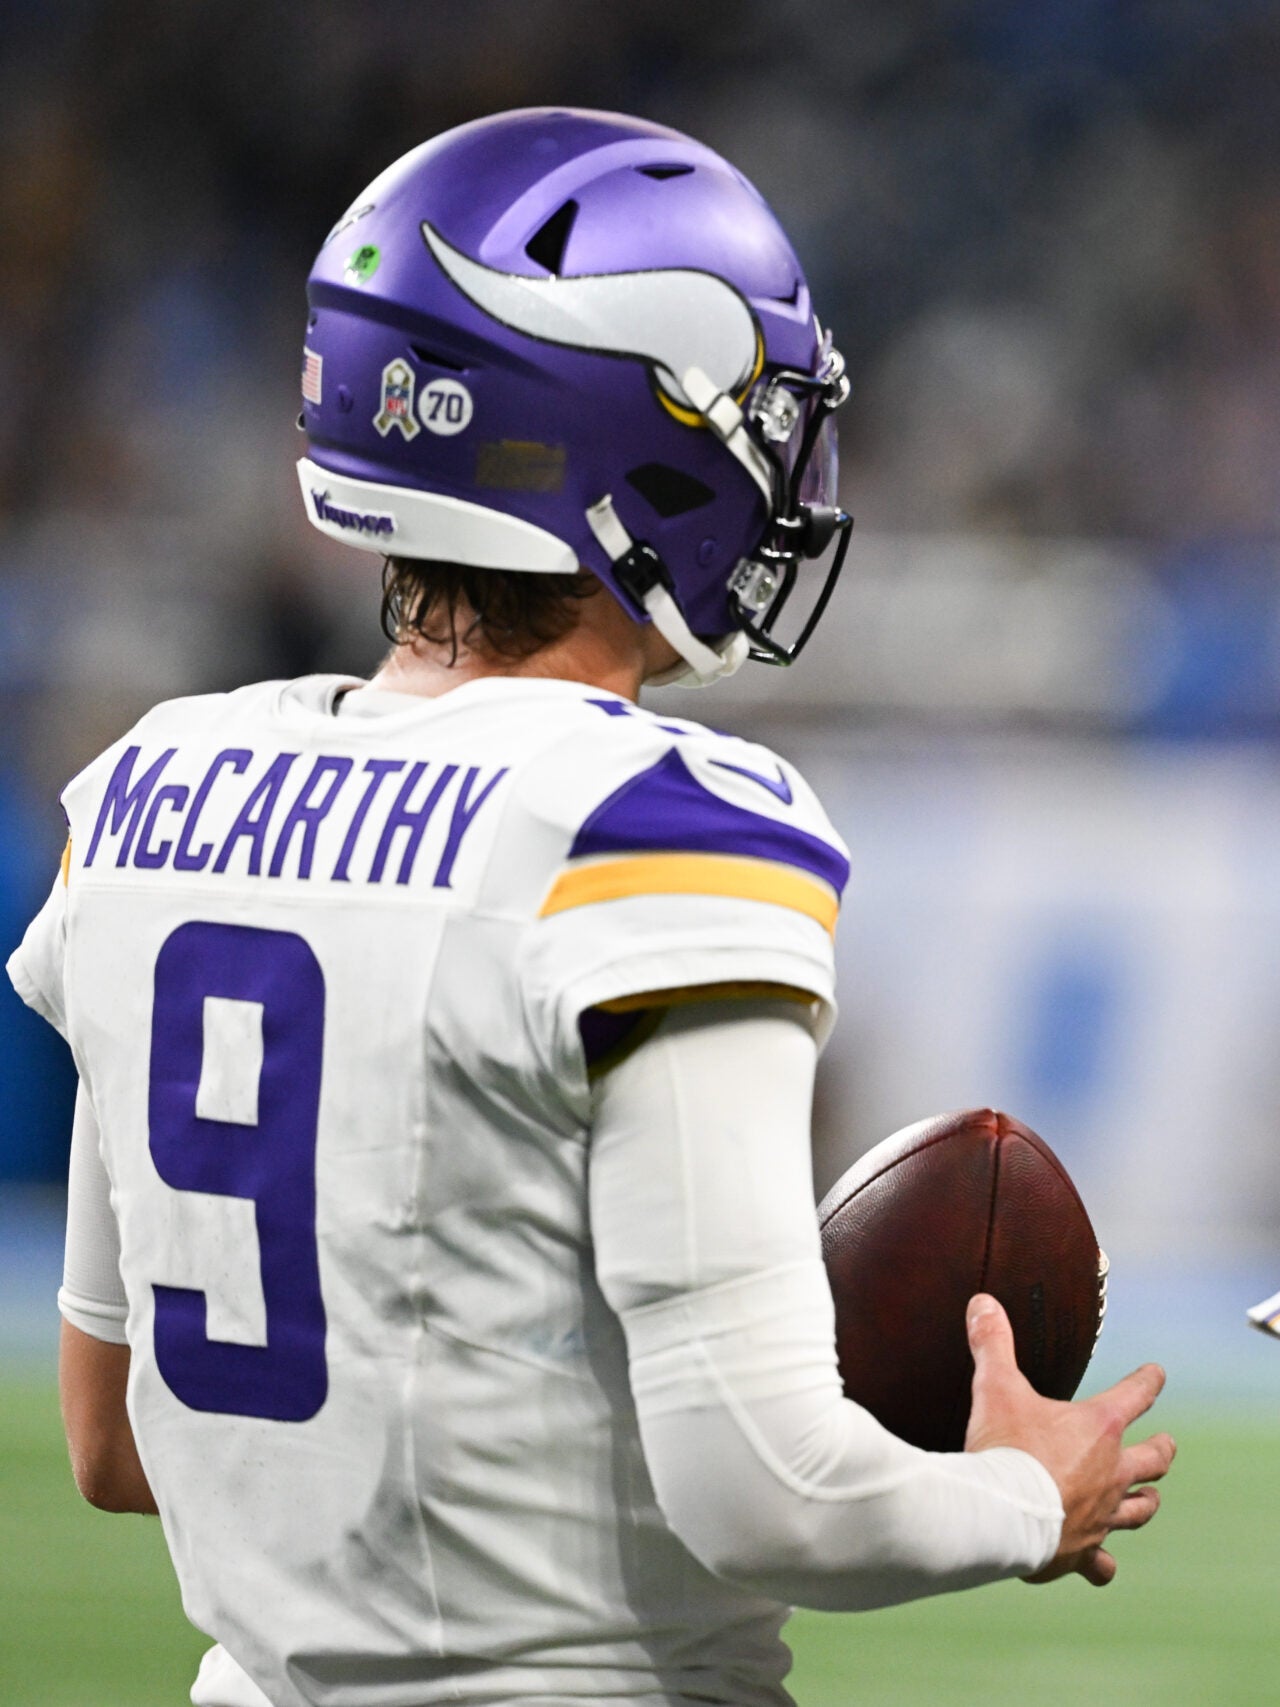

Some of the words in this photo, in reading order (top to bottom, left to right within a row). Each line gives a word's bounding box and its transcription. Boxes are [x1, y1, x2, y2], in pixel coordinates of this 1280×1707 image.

[428, 391, 463, 424] 70
[83, 745, 511, 889] McCARTHY
[148, 920, 329, 1423] 9
